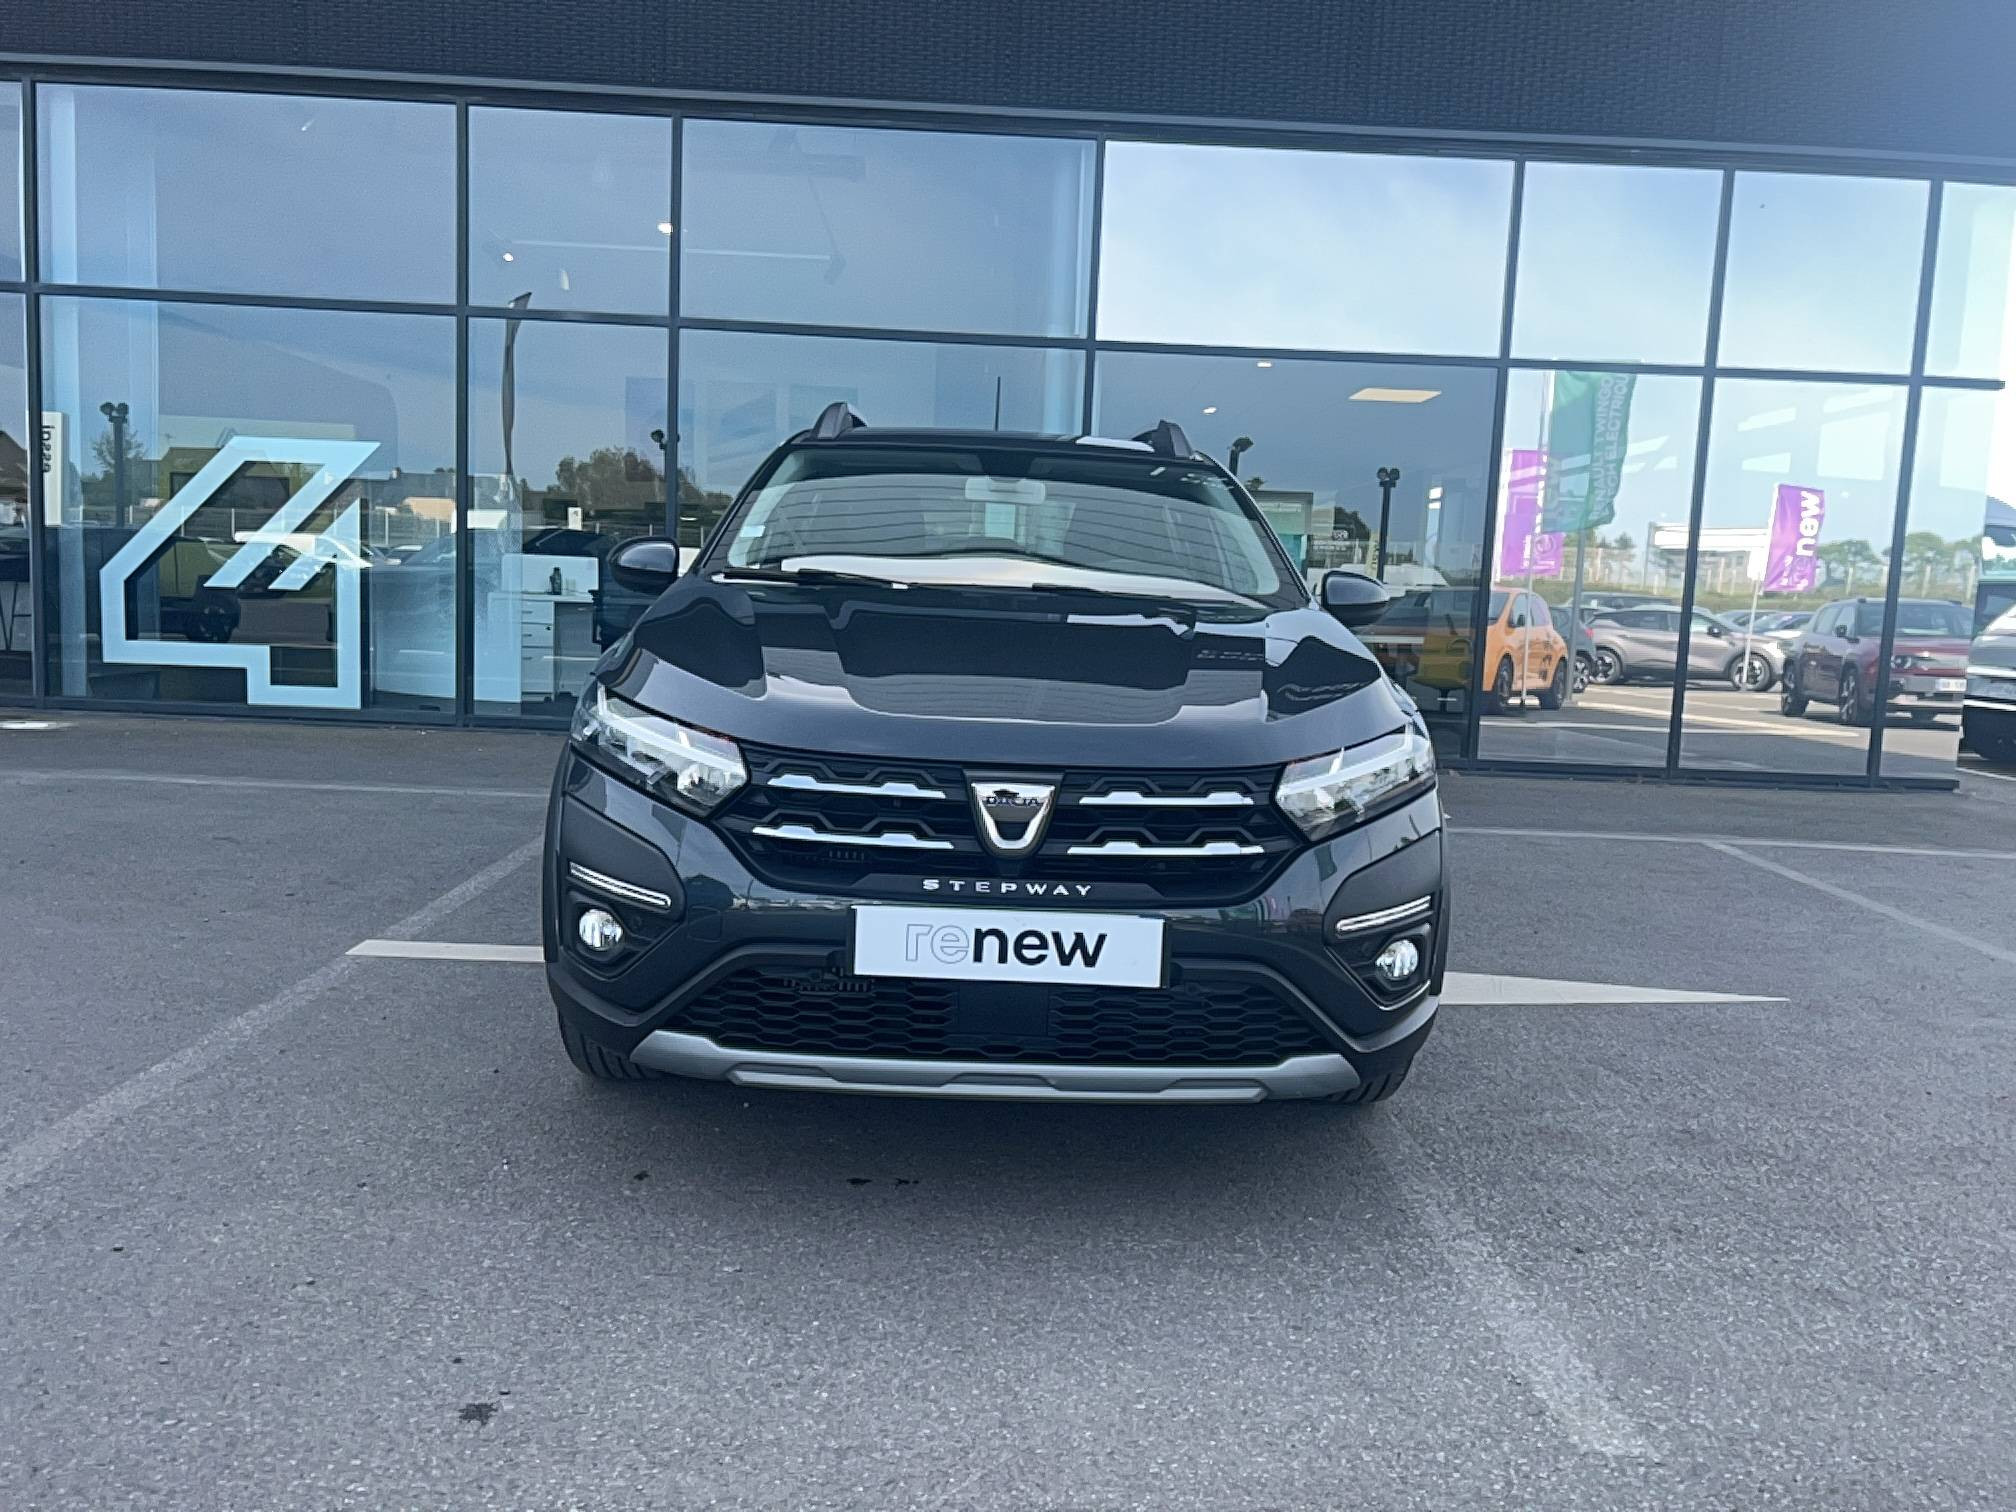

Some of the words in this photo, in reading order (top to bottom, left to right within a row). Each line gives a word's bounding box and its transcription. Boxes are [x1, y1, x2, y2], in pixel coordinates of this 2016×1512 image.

[1594, 377, 1614, 443] TWINGO
[922, 879, 1092, 896] STEPWAY
[905, 923, 1107, 968] renew
